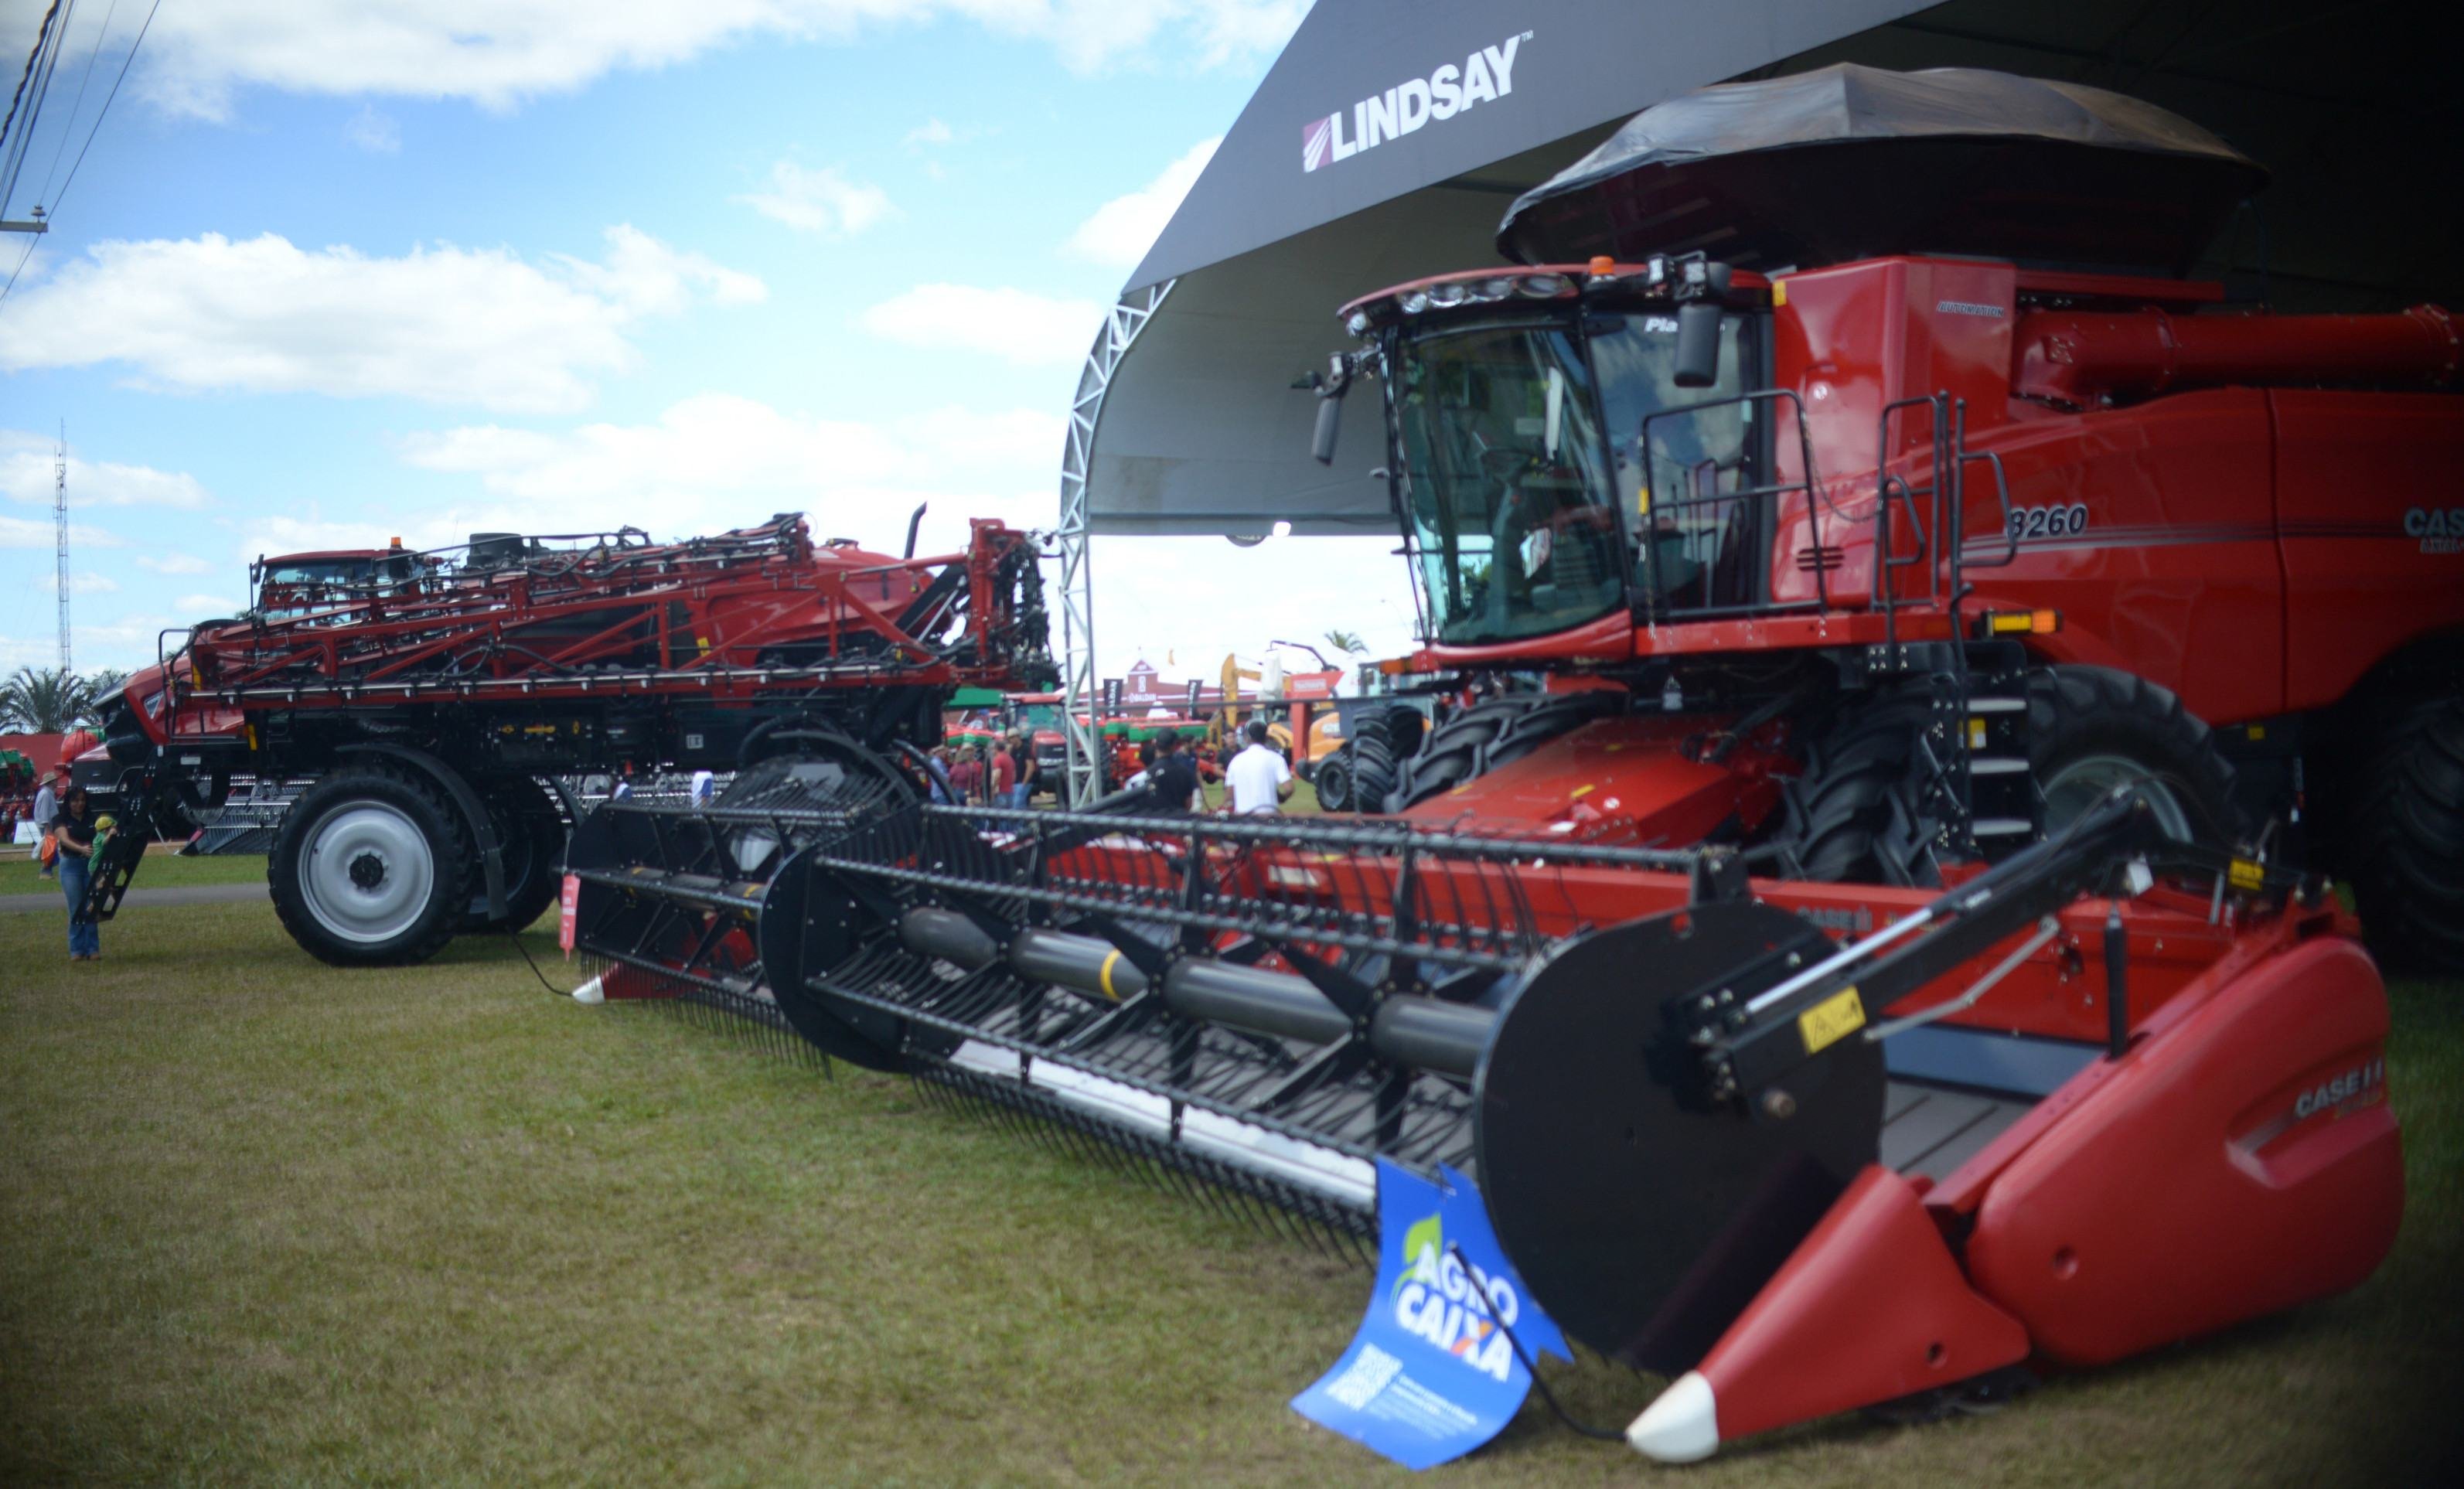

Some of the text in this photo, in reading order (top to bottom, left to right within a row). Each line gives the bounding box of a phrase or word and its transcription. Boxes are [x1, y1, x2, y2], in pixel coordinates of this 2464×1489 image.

[1330, 35, 1520, 162] LINDSAY
[2006, 503, 2087, 539] 8260
[2295, 1067, 2360, 1118] CASE
[1396, 1283, 1513, 1384] CAIXA
